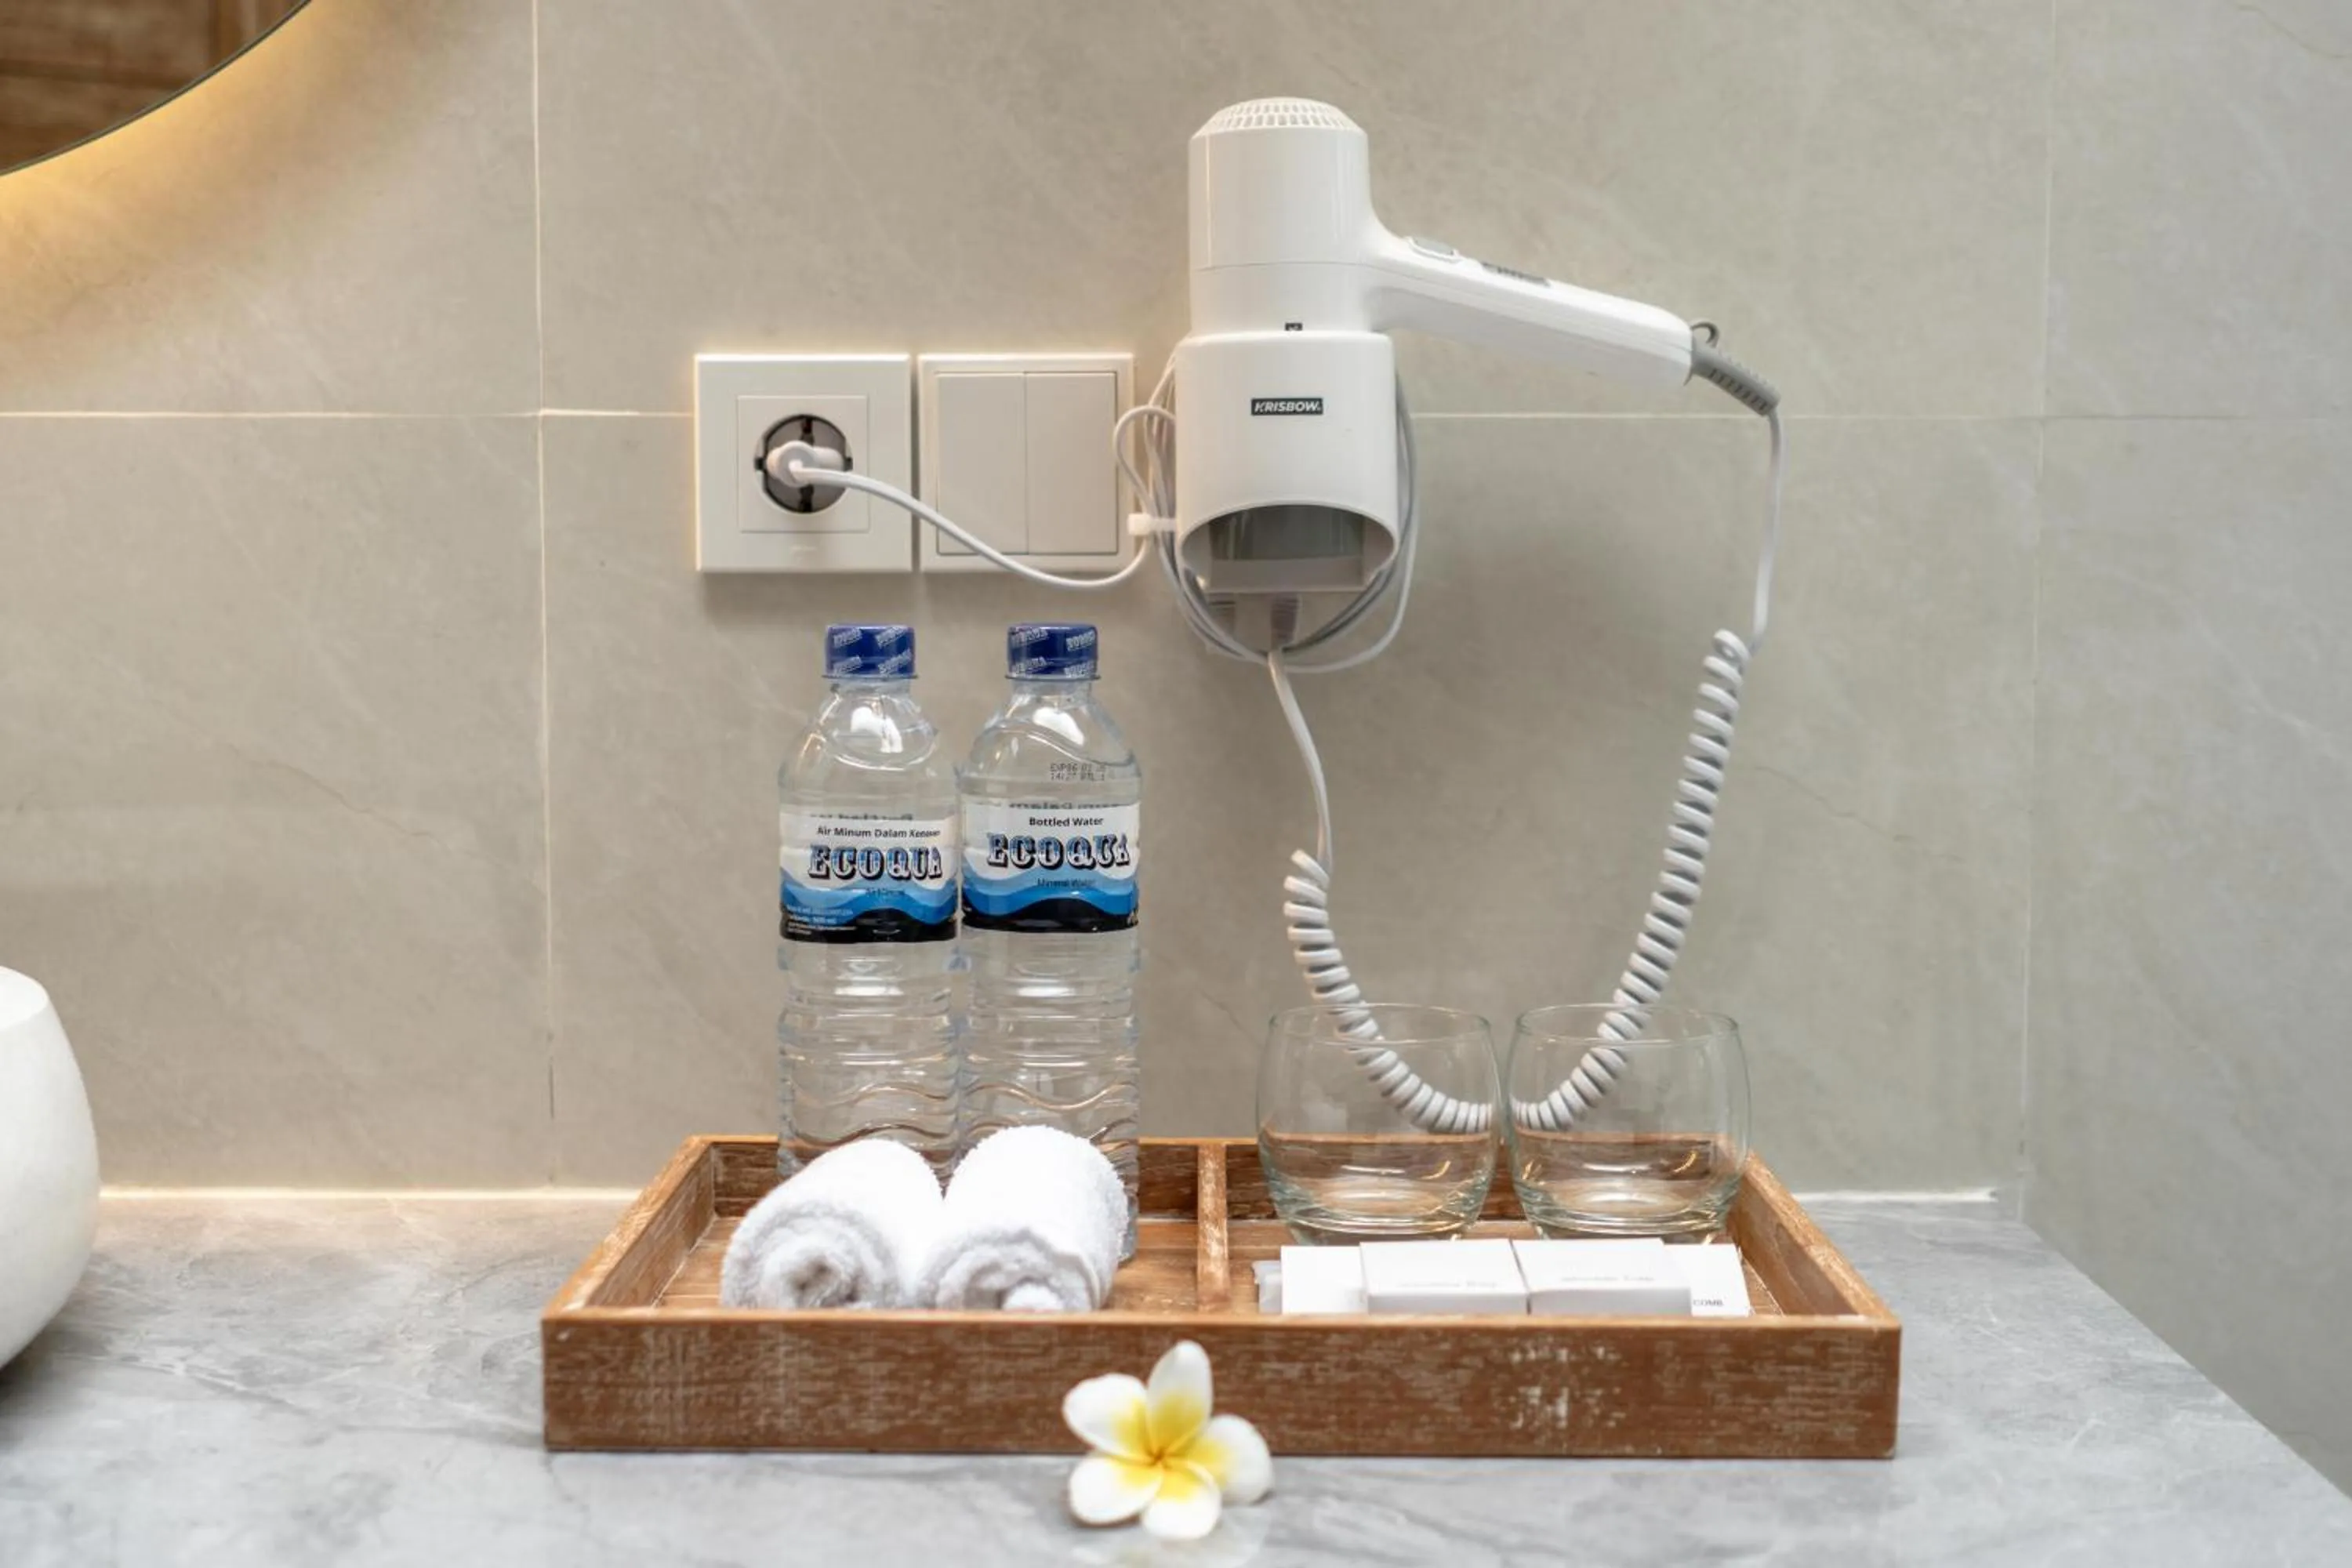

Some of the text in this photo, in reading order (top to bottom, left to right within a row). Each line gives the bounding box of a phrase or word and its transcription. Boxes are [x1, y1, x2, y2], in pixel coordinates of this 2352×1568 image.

[817, 826, 831, 835] Air
[833, 827, 871, 837] Minum
[874, 829, 907, 837] Dalam
[1029, 817, 1104, 826] Bottled Water
[808, 844, 943, 881] ECOQUA
[986, 833, 1131, 870] ECOQUA
